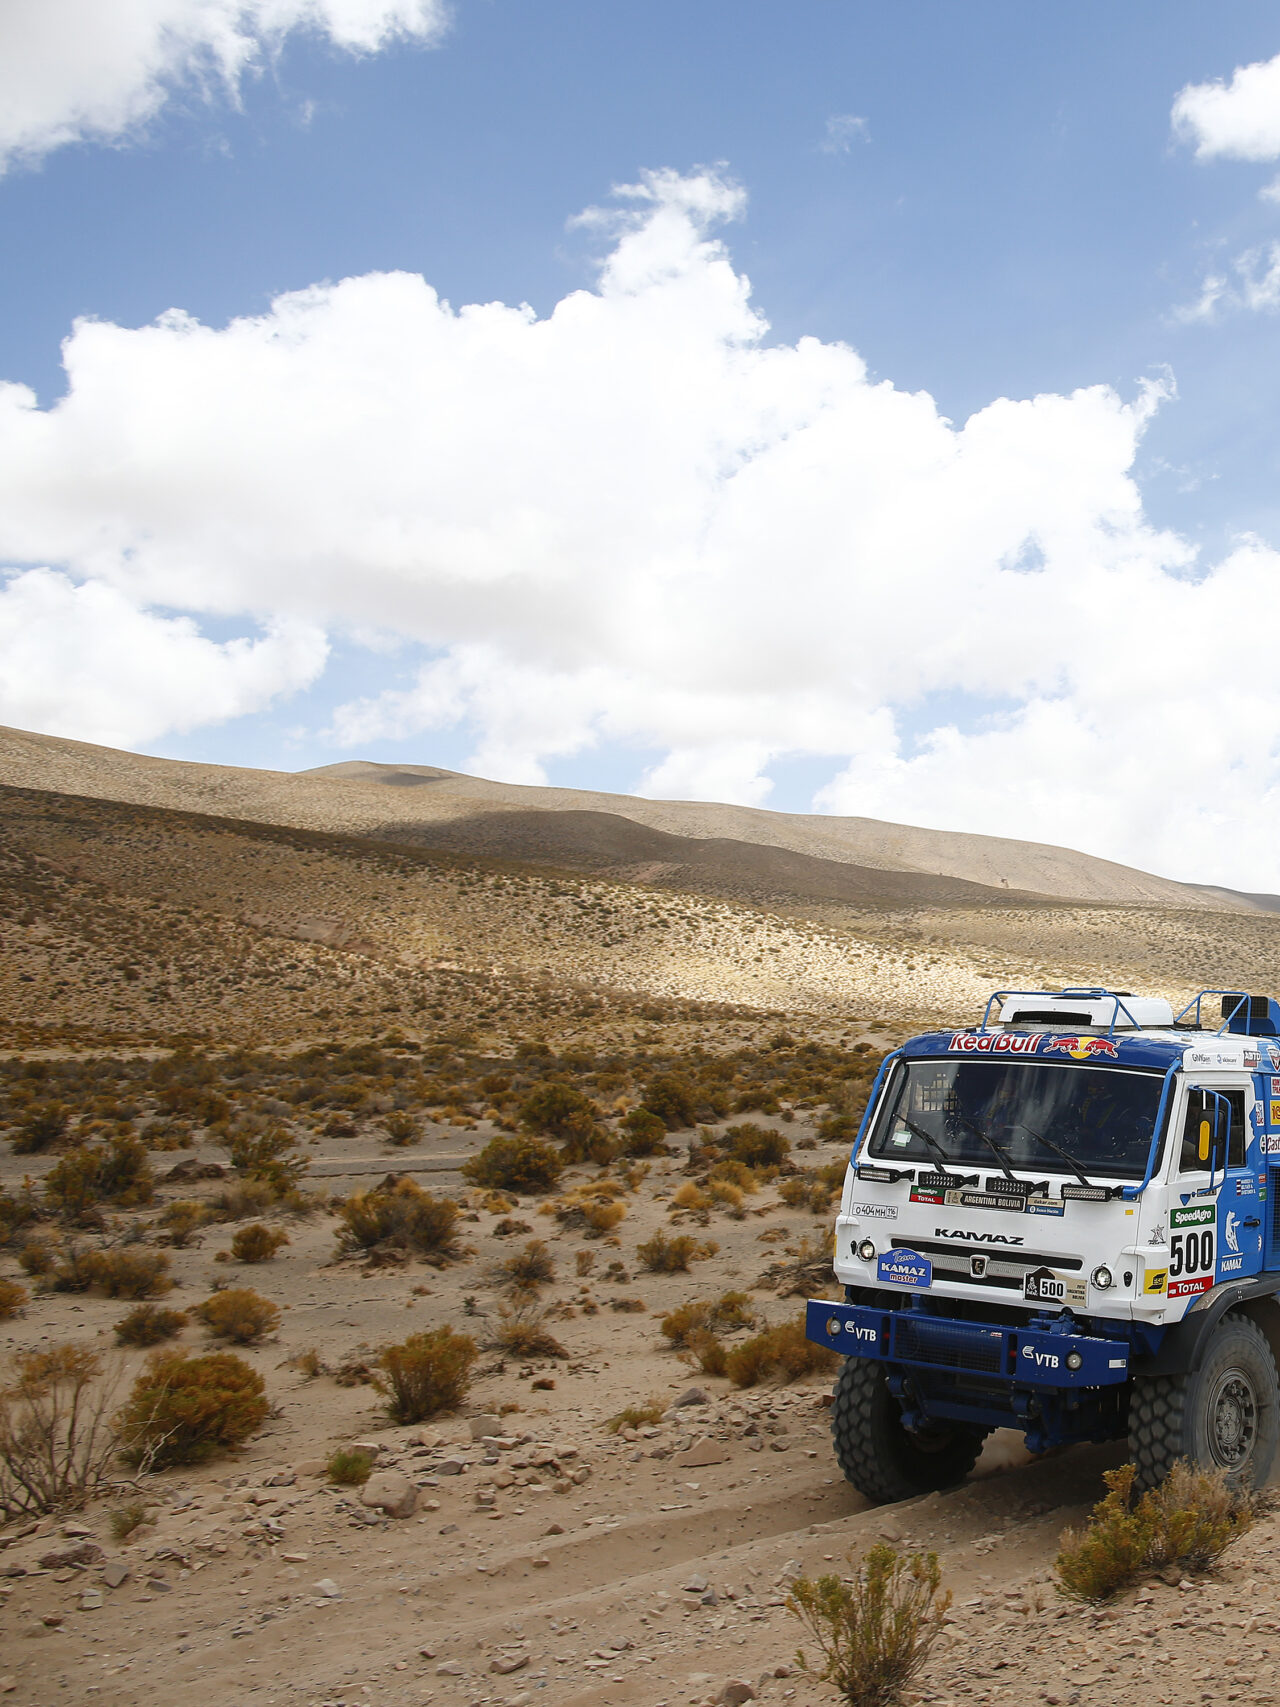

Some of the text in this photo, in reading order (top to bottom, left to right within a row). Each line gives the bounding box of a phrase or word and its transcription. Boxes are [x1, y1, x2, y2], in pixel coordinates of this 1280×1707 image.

[948, 1033, 1045, 1053] Red Bull
[964, 1195, 996, 1206] ARGENTINA
[998, 1198, 1021, 1208] BOLIVIA
[1175, 1209, 1212, 1224] SpeedAgro
[935, 1228, 1025, 1246] KAMAZ
[893, 1250, 916, 1263] Team
[1169, 1230, 1213, 1277] 500
[881, 1262, 926, 1277] KAMAZ
[1221, 1258, 1243, 1272] KAMAZ
[890, 1273, 918, 1283] master
[1041, 1281, 1064, 1297] 500
[1177, 1282, 1205, 1293] TOTAL
[856, 1327, 876, 1341] VTB
[1035, 1352, 1059, 1368] VTB
